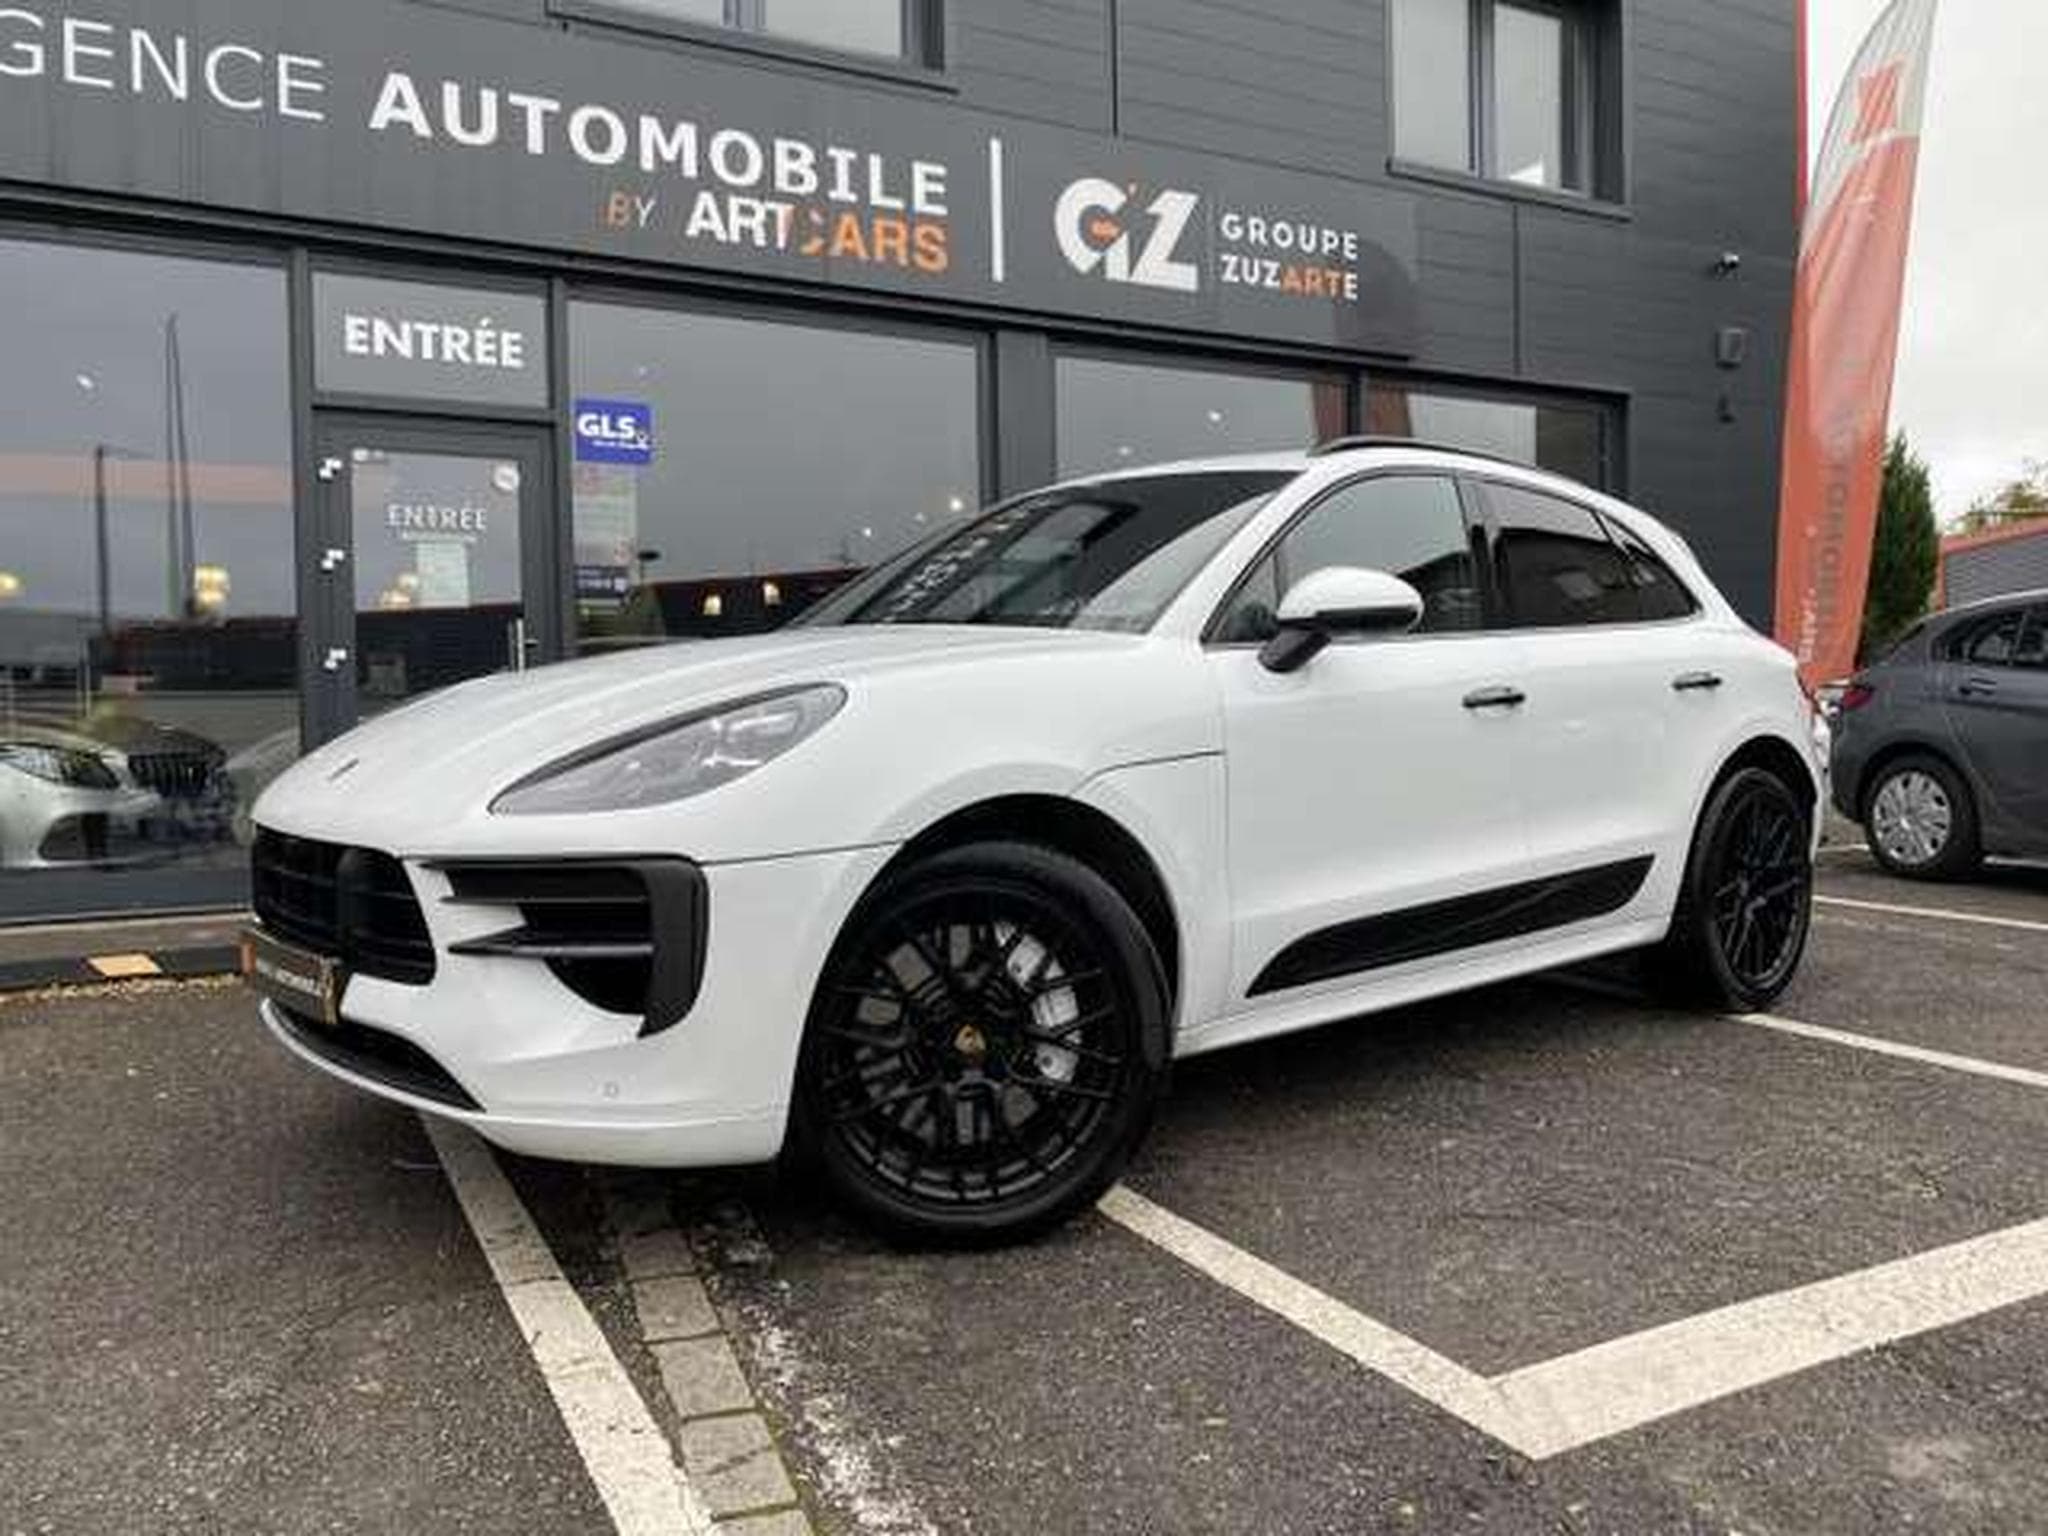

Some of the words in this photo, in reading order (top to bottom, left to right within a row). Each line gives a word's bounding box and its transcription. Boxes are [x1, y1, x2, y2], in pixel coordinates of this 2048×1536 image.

[369, 72, 948, 216] AUTOMOBILE
[607, 191, 656, 228] BY
[1220, 213, 1359, 260] GROUPE
[1220, 254, 1359, 300] ZUZARTE
[344, 314, 525, 369] ENTRÉE
[578, 412, 636, 439] GLS
